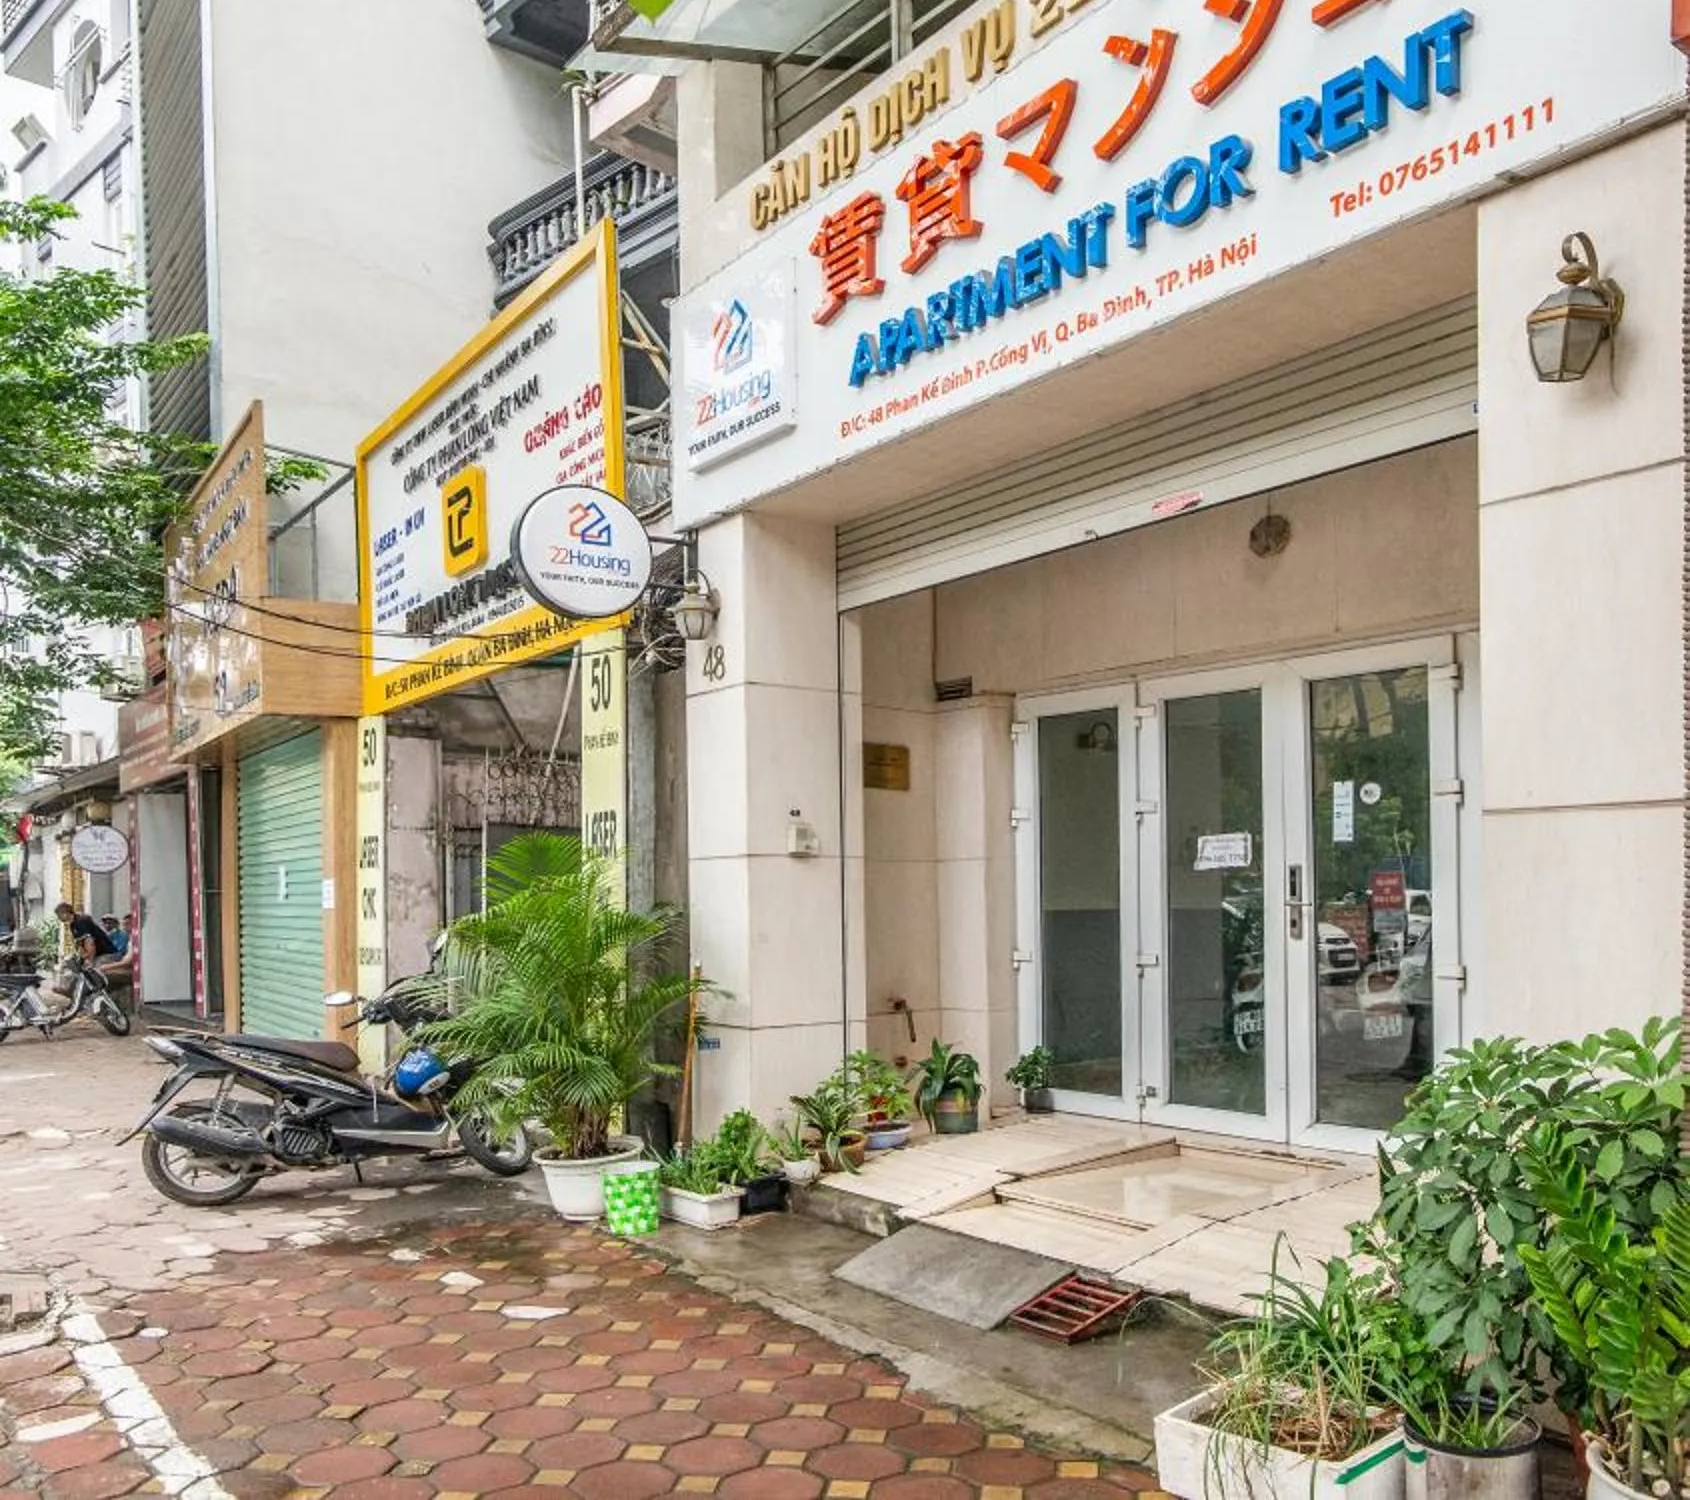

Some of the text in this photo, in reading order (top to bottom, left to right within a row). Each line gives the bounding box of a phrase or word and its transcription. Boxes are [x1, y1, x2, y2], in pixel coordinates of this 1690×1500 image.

[817, 107, 860, 188] HỘ
[868, 46, 950, 153] DỊCH
[1329, 97, 1554, 218] Tel: 0765141111
[848, 7, 1475, 388] APARTMENT FOR RENT
[869, 406, 883, 425] 48
[1188, 254, 1215, 284] Hà
[1221, 233, 1258, 268] Nội
[549, 545, 631, 577] 22Housing
[591, 653, 612, 713] 50
[703, 644, 726, 683] 48
[363, 727, 377, 768] 50
